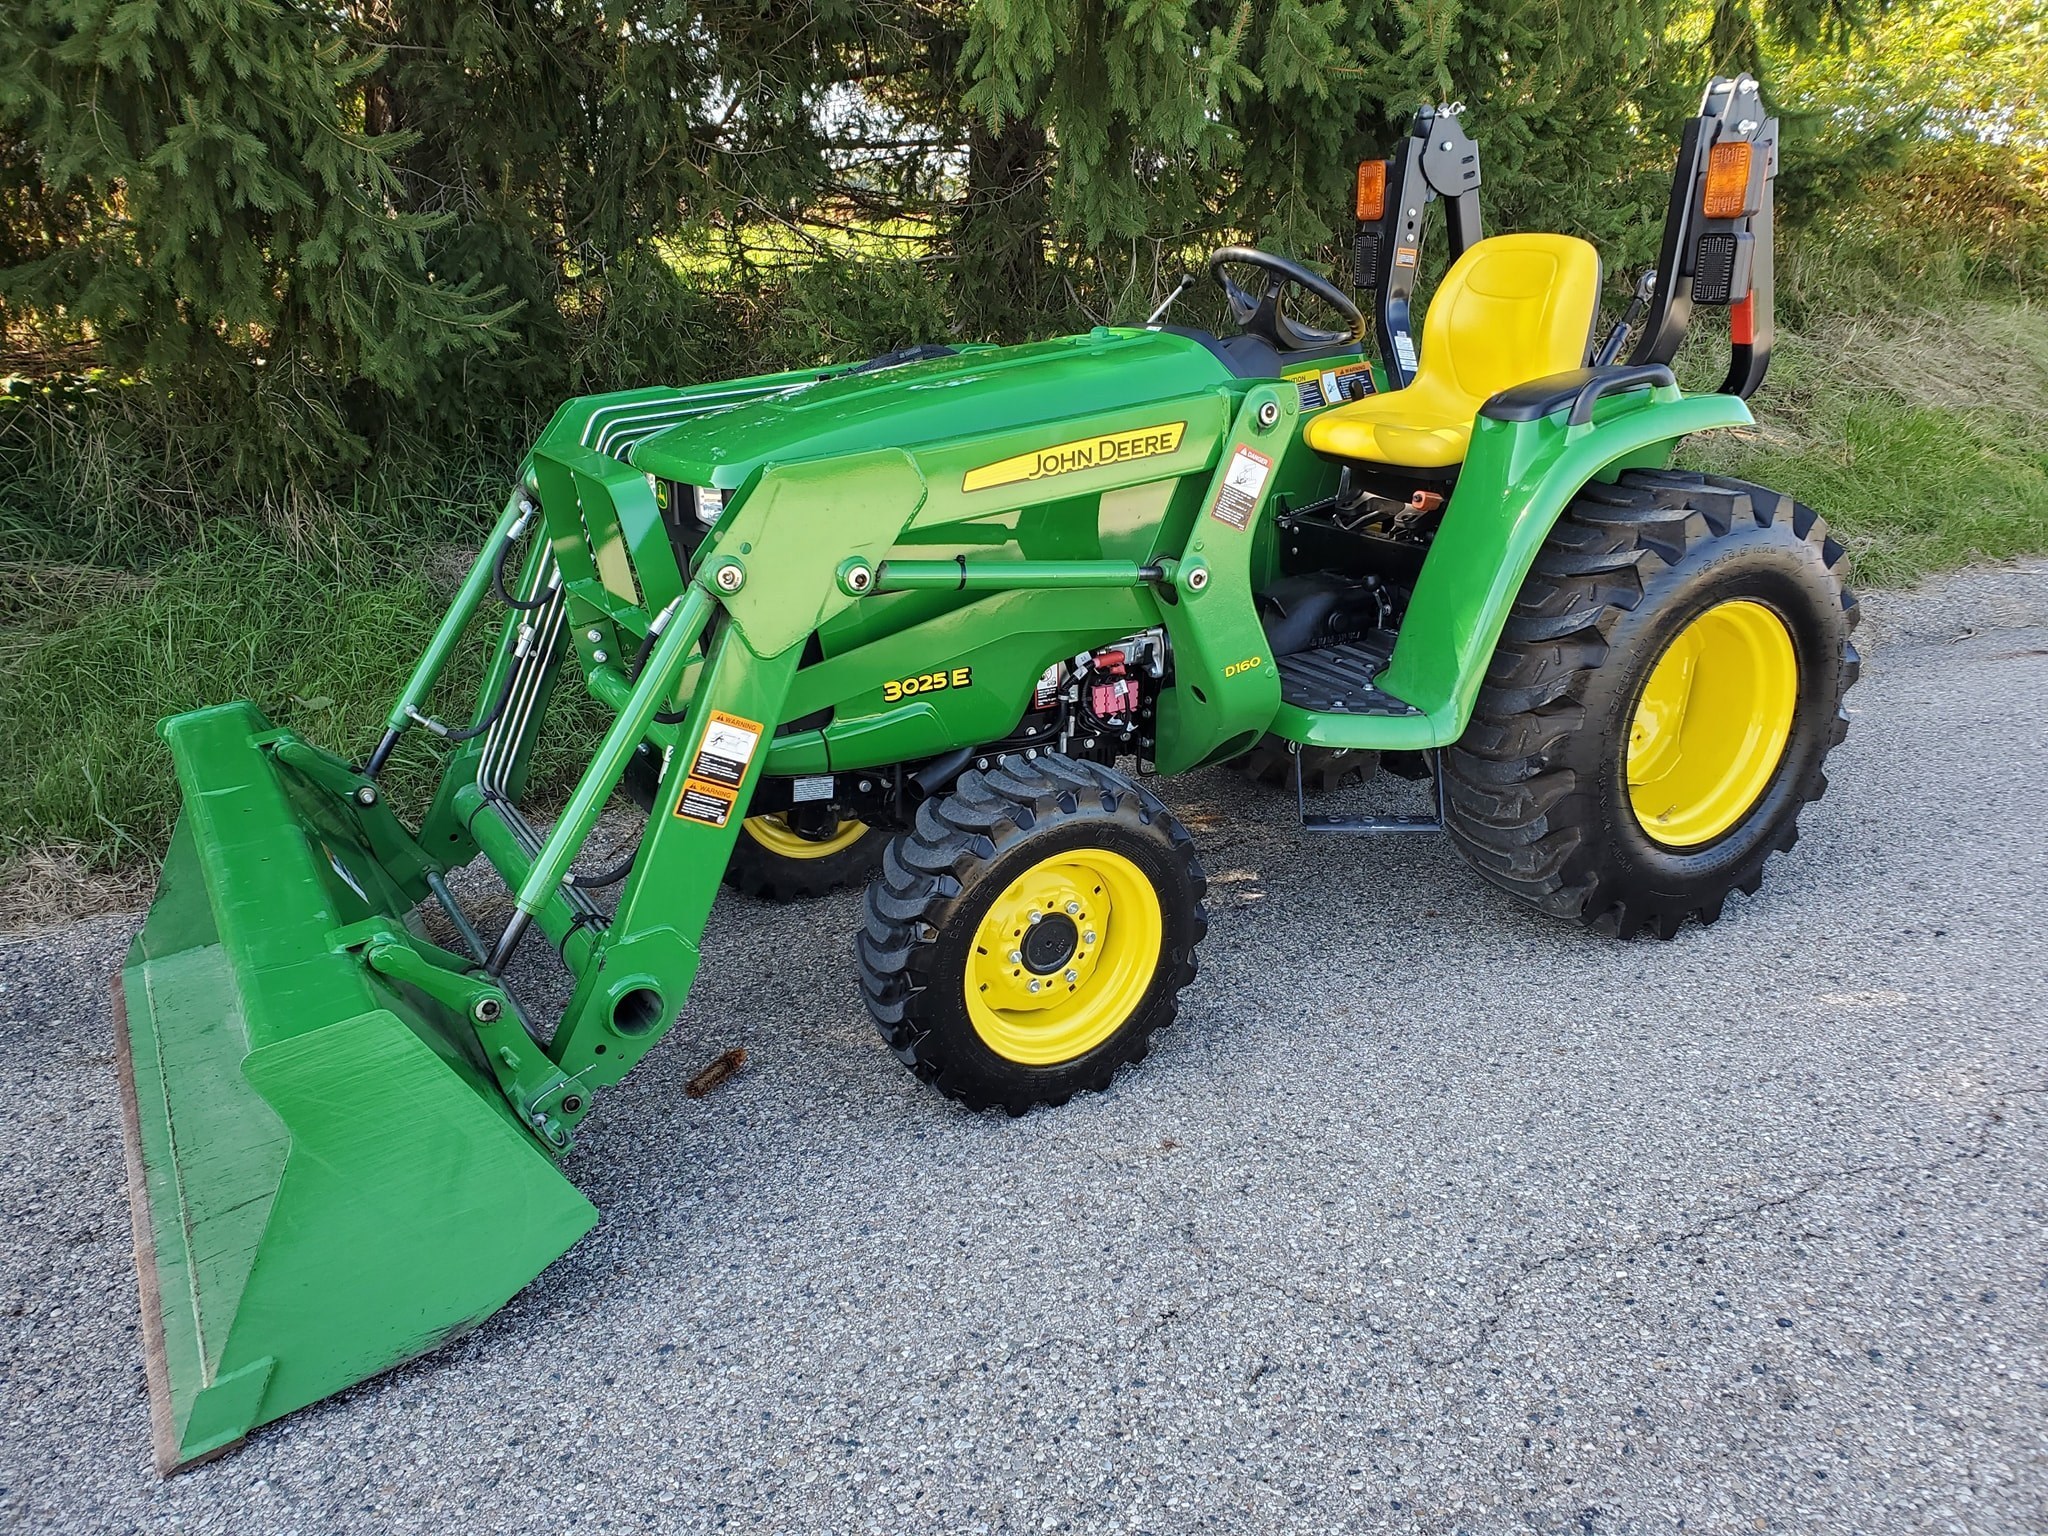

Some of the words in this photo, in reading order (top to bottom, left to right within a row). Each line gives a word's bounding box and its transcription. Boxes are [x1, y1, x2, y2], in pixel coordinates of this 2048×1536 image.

[1029, 447, 1092, 477] JOHN
[1098, 432, 1173, 462] DEERE
[1225, 656, 1261, 678] D160
[725, 716, 757, 731] WARNING
[700, 784, 732, 798] WARNING
